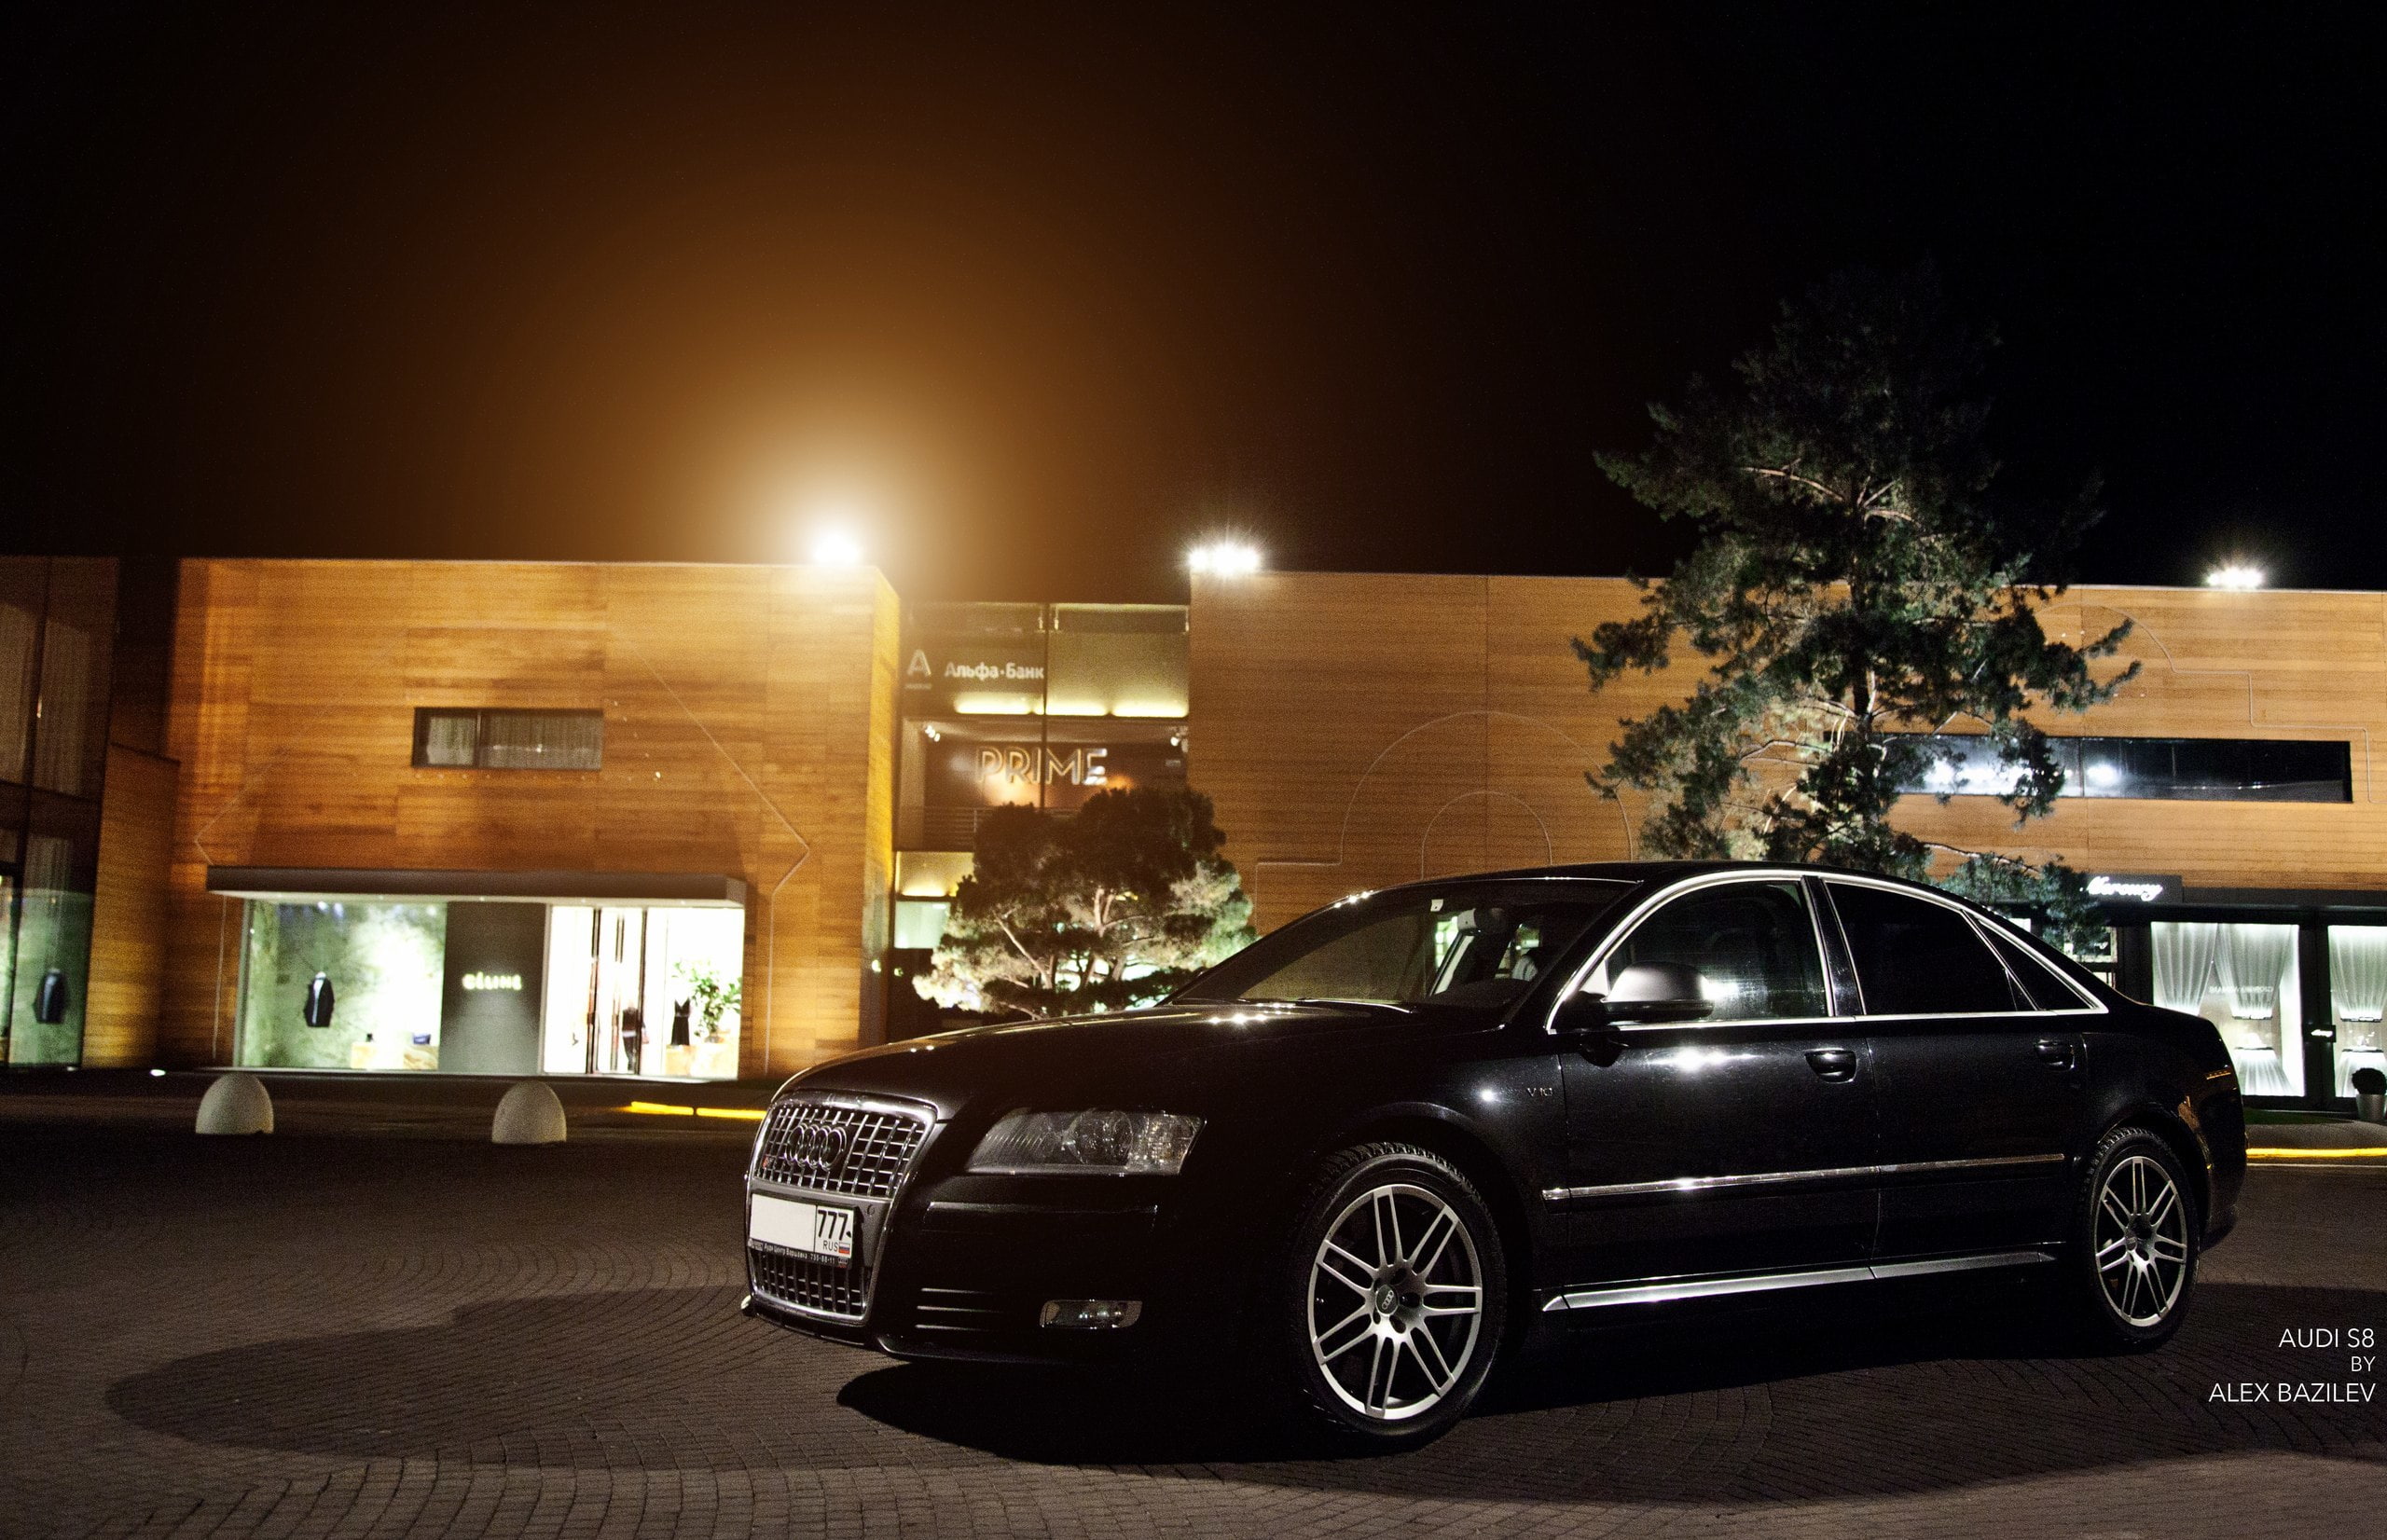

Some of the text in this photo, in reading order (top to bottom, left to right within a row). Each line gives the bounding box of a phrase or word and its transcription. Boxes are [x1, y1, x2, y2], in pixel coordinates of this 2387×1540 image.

[978, 747, 1108, 786] PRIME
[818, 1209, 849, 1241] 777
[822, 1240, 839, 1252] RUS
